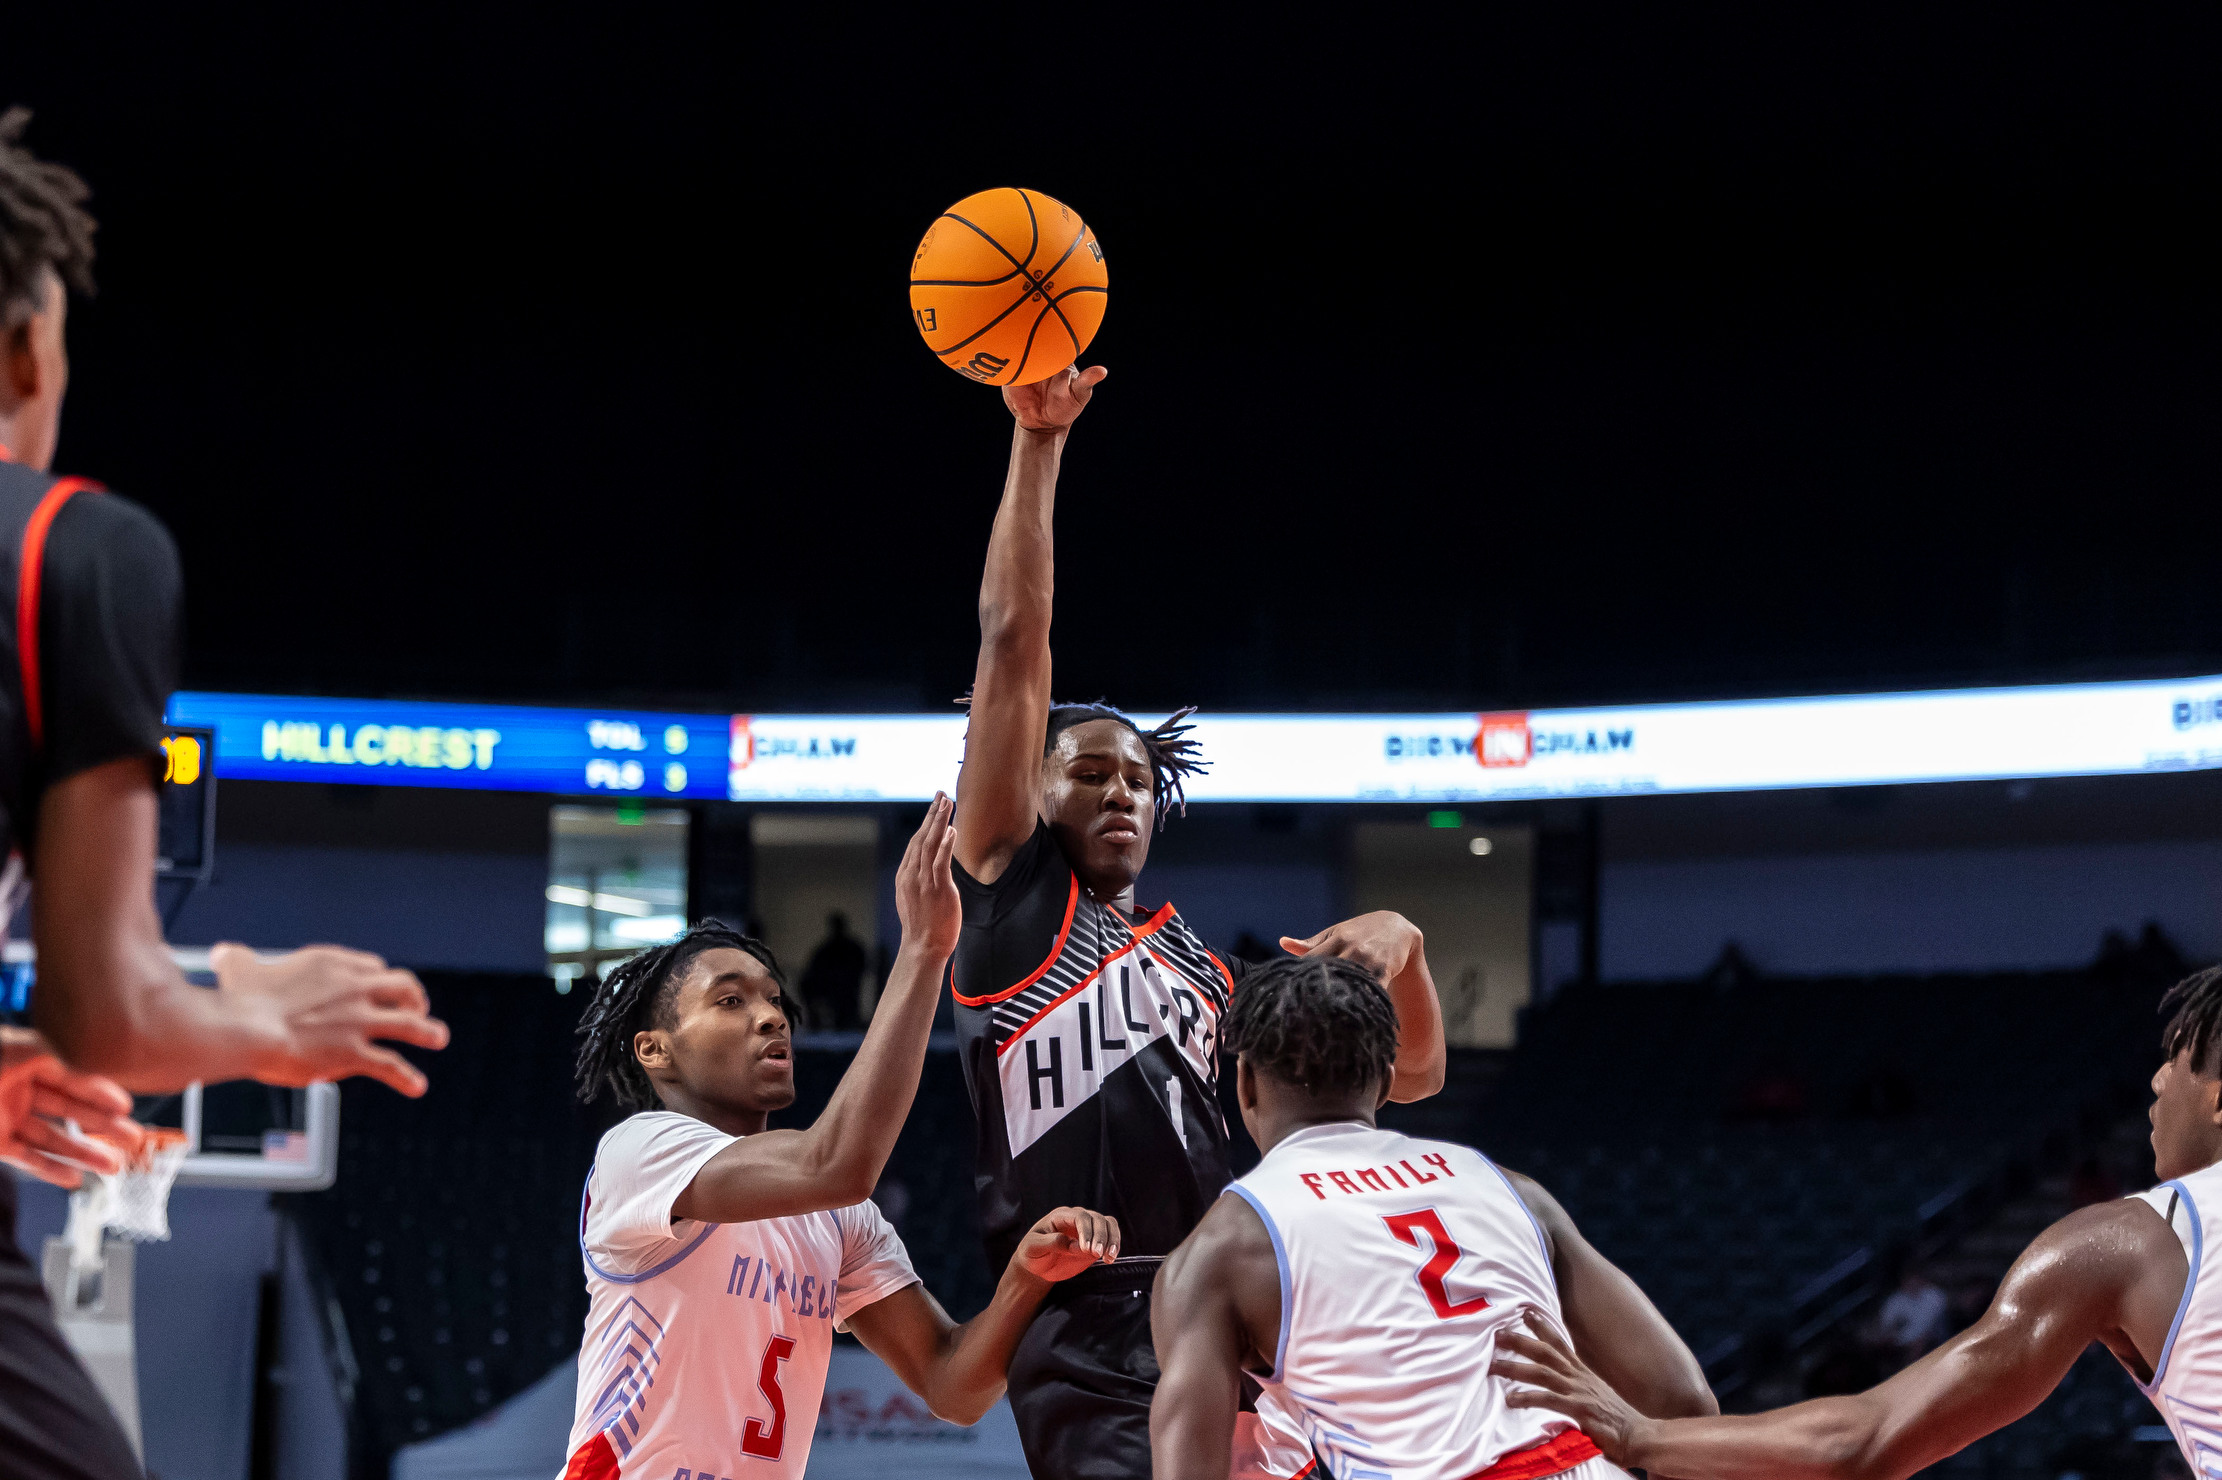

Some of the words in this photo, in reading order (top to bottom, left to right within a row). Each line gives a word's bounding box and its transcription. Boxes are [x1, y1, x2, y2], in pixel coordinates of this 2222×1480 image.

[262, 720, 501, 770] HILLCREST
[1300, 1153, 1455, 1200] FAMILY
[1378, 1205, 1497, 1322] 2
[740, 1333, 797, 1462] 5
